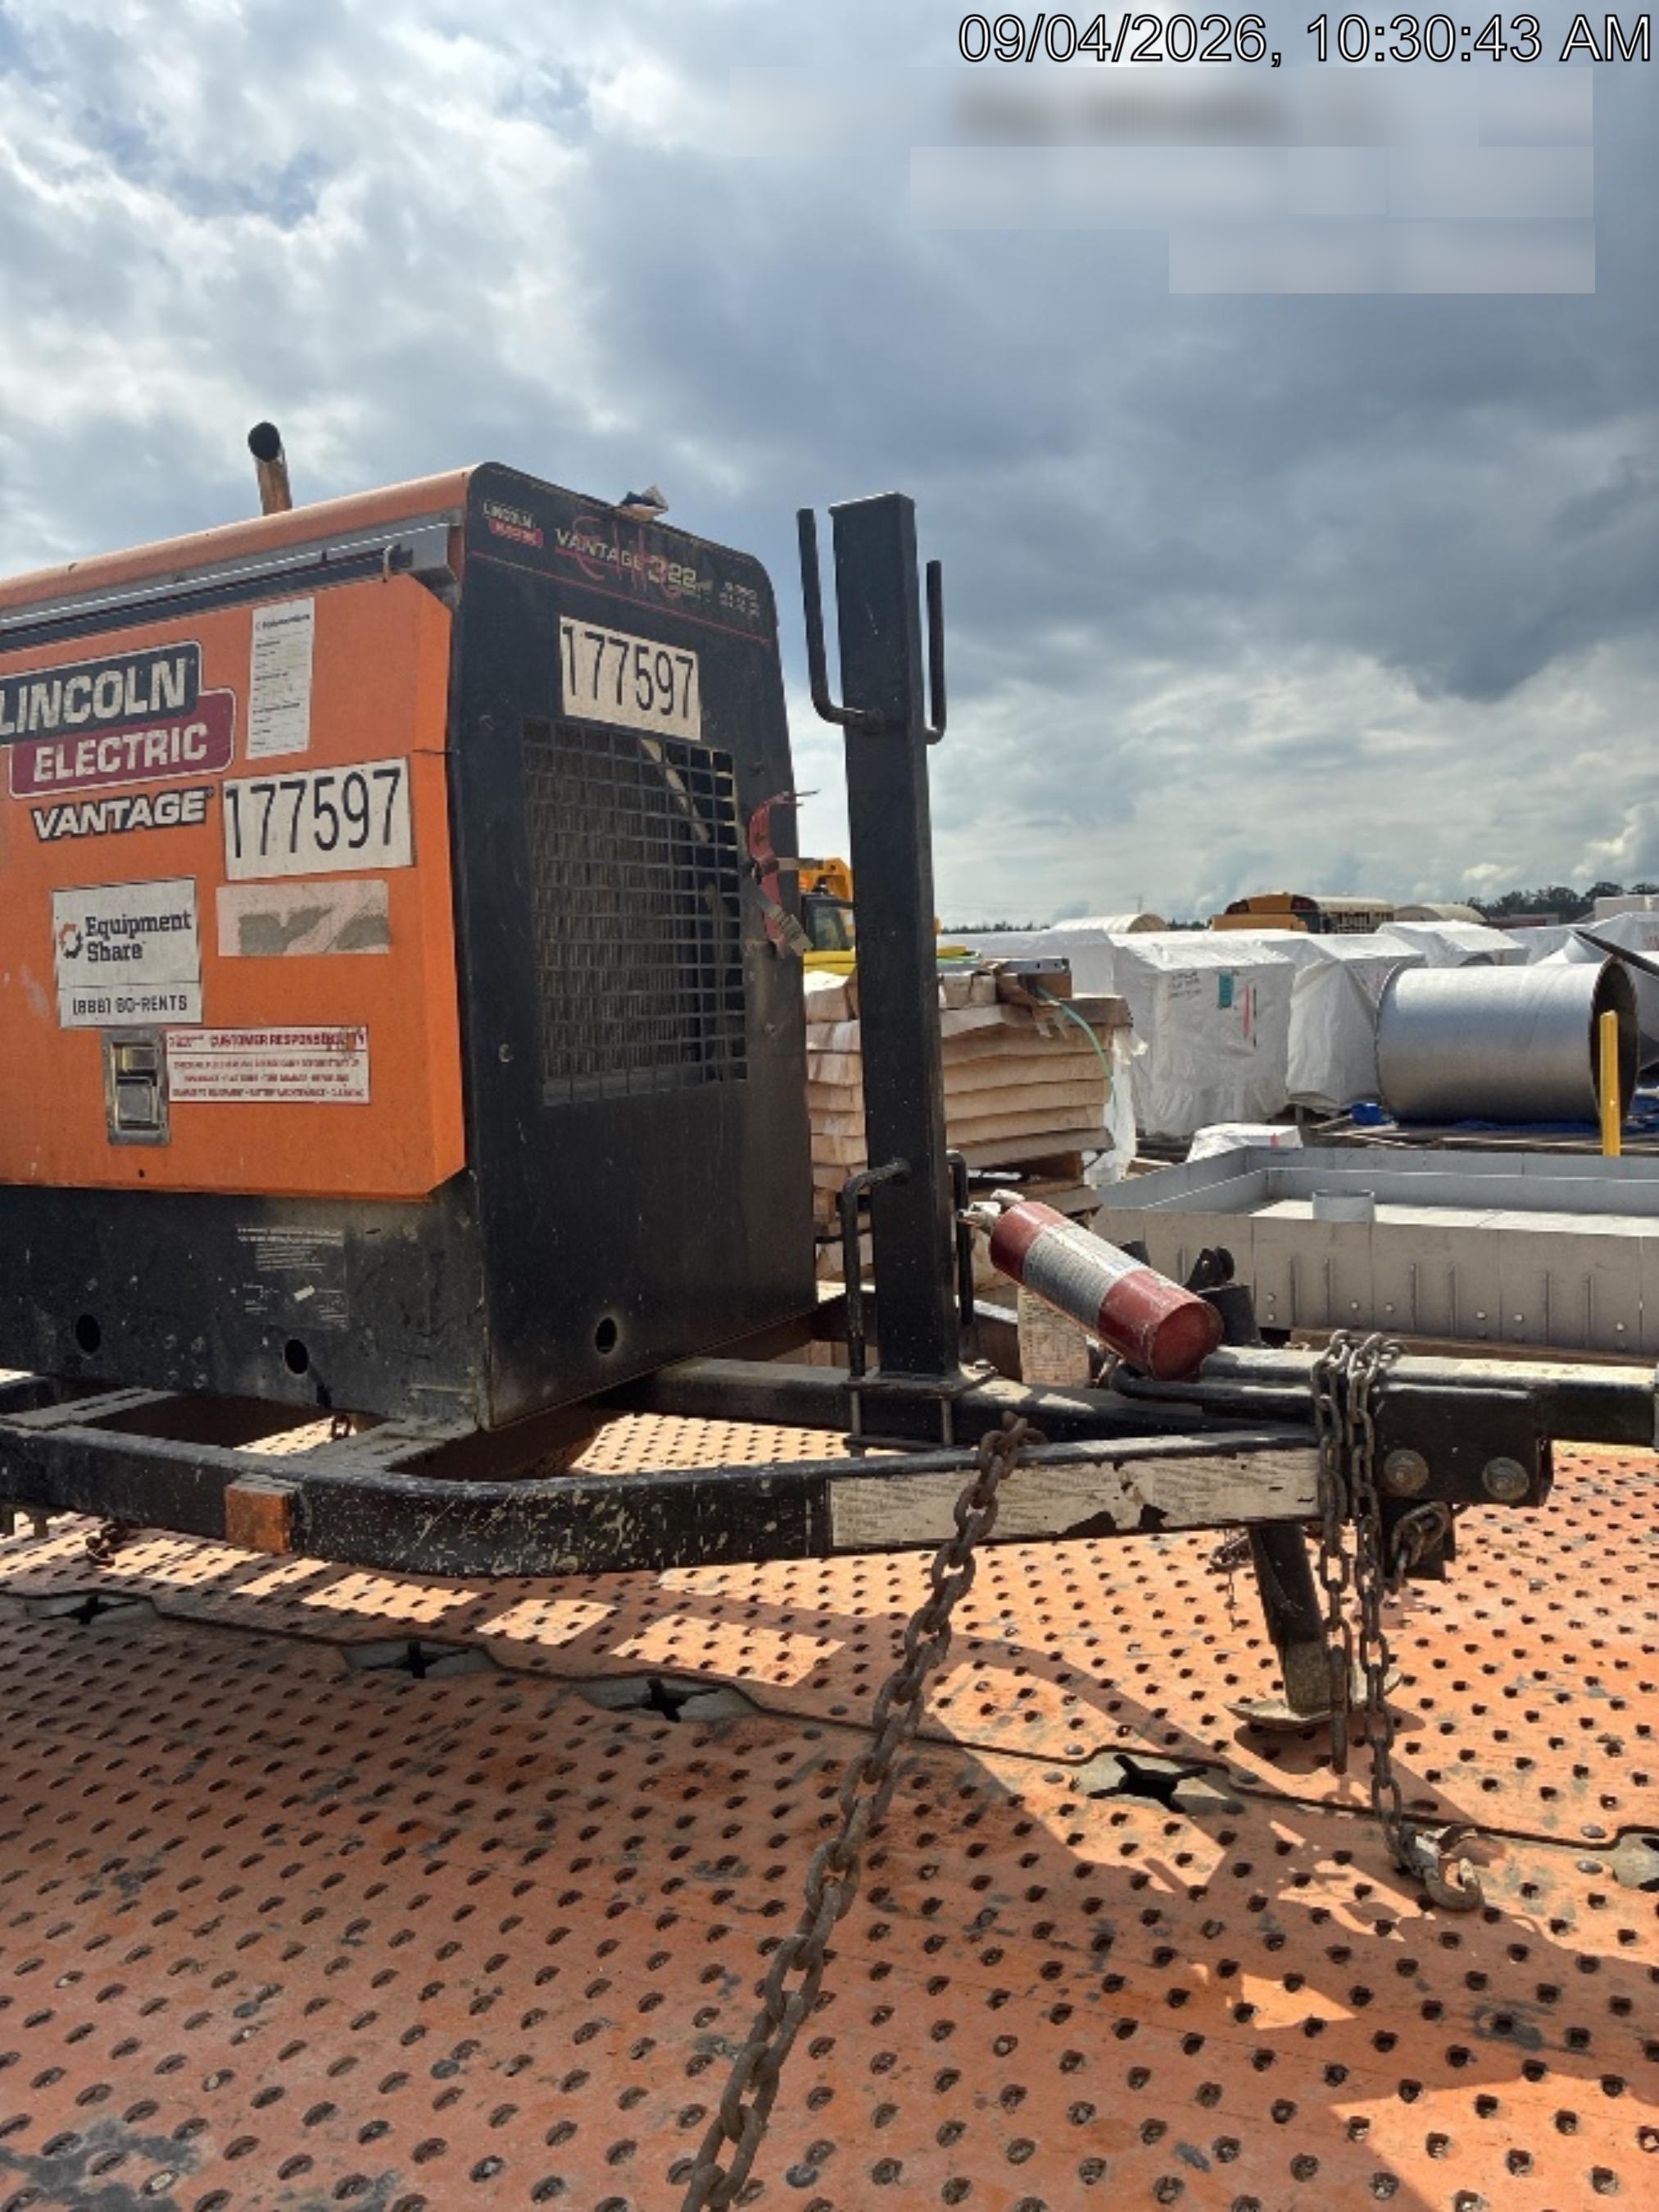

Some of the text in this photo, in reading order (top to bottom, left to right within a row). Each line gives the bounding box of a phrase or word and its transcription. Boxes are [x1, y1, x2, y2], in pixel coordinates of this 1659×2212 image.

[555, 528, 644, 571] VANTAGE
[563, 626, 694, 719] 177597
[0, 658, 187, 736] LINCOLN
[34, 723, 208, 782] ELECTRIC
[32, 787, 210, 841] VANTAGE
[225, 768, 402, 859] 177597
[85, 909, 192, 940] Equipment
[87, 941, 143, 962] Share
[73, 996, 111, 1015] (888)
[270, 1031, 365, 1046] RESPONSIBY
